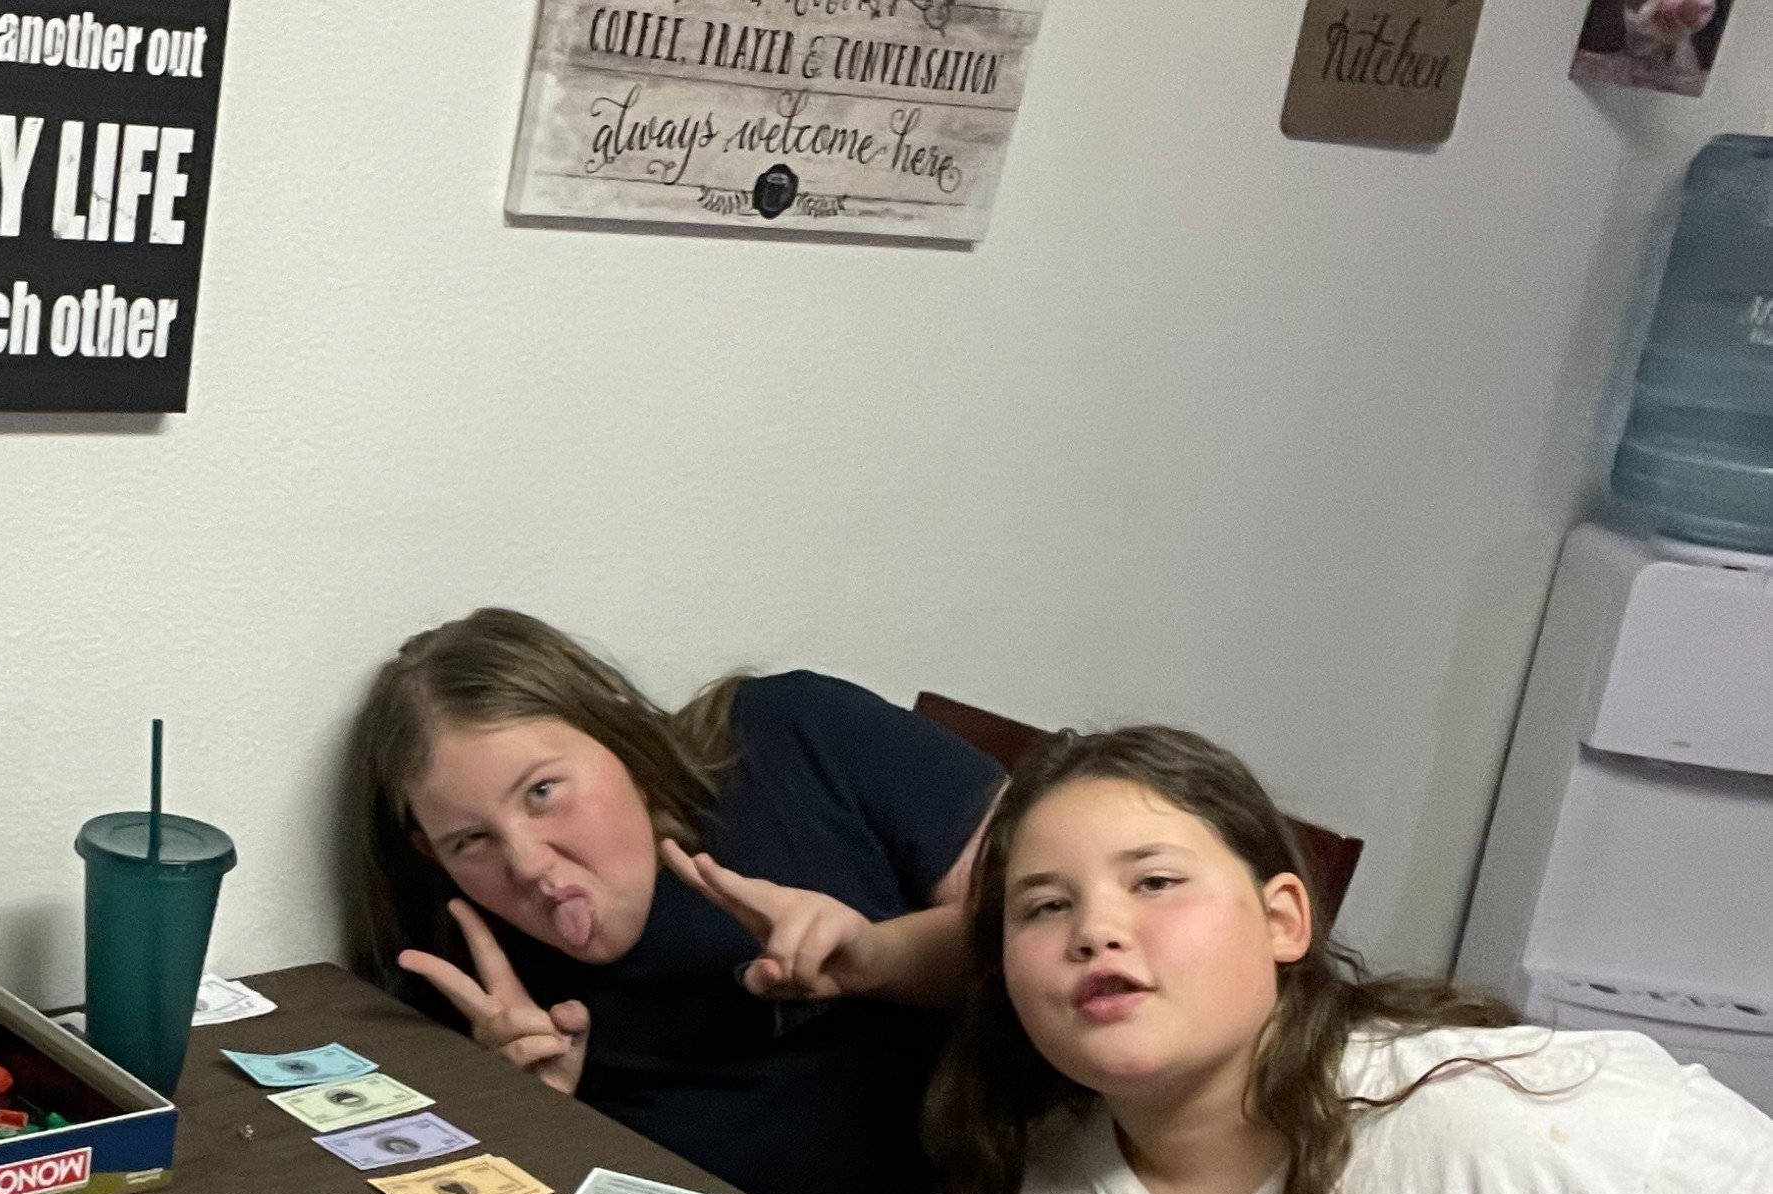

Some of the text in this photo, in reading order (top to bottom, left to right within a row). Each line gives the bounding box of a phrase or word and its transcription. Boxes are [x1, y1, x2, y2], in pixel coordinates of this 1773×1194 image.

[146, 26, 207, 78] out
[699, 21, 795, 75] PRAYER
[827, 34, 1004, 94] CONVERSATION
[584, 82, 962, 193] always welcome here
[52, 119, 195, 246] LIFE
[49, 283, 179, 359] other
